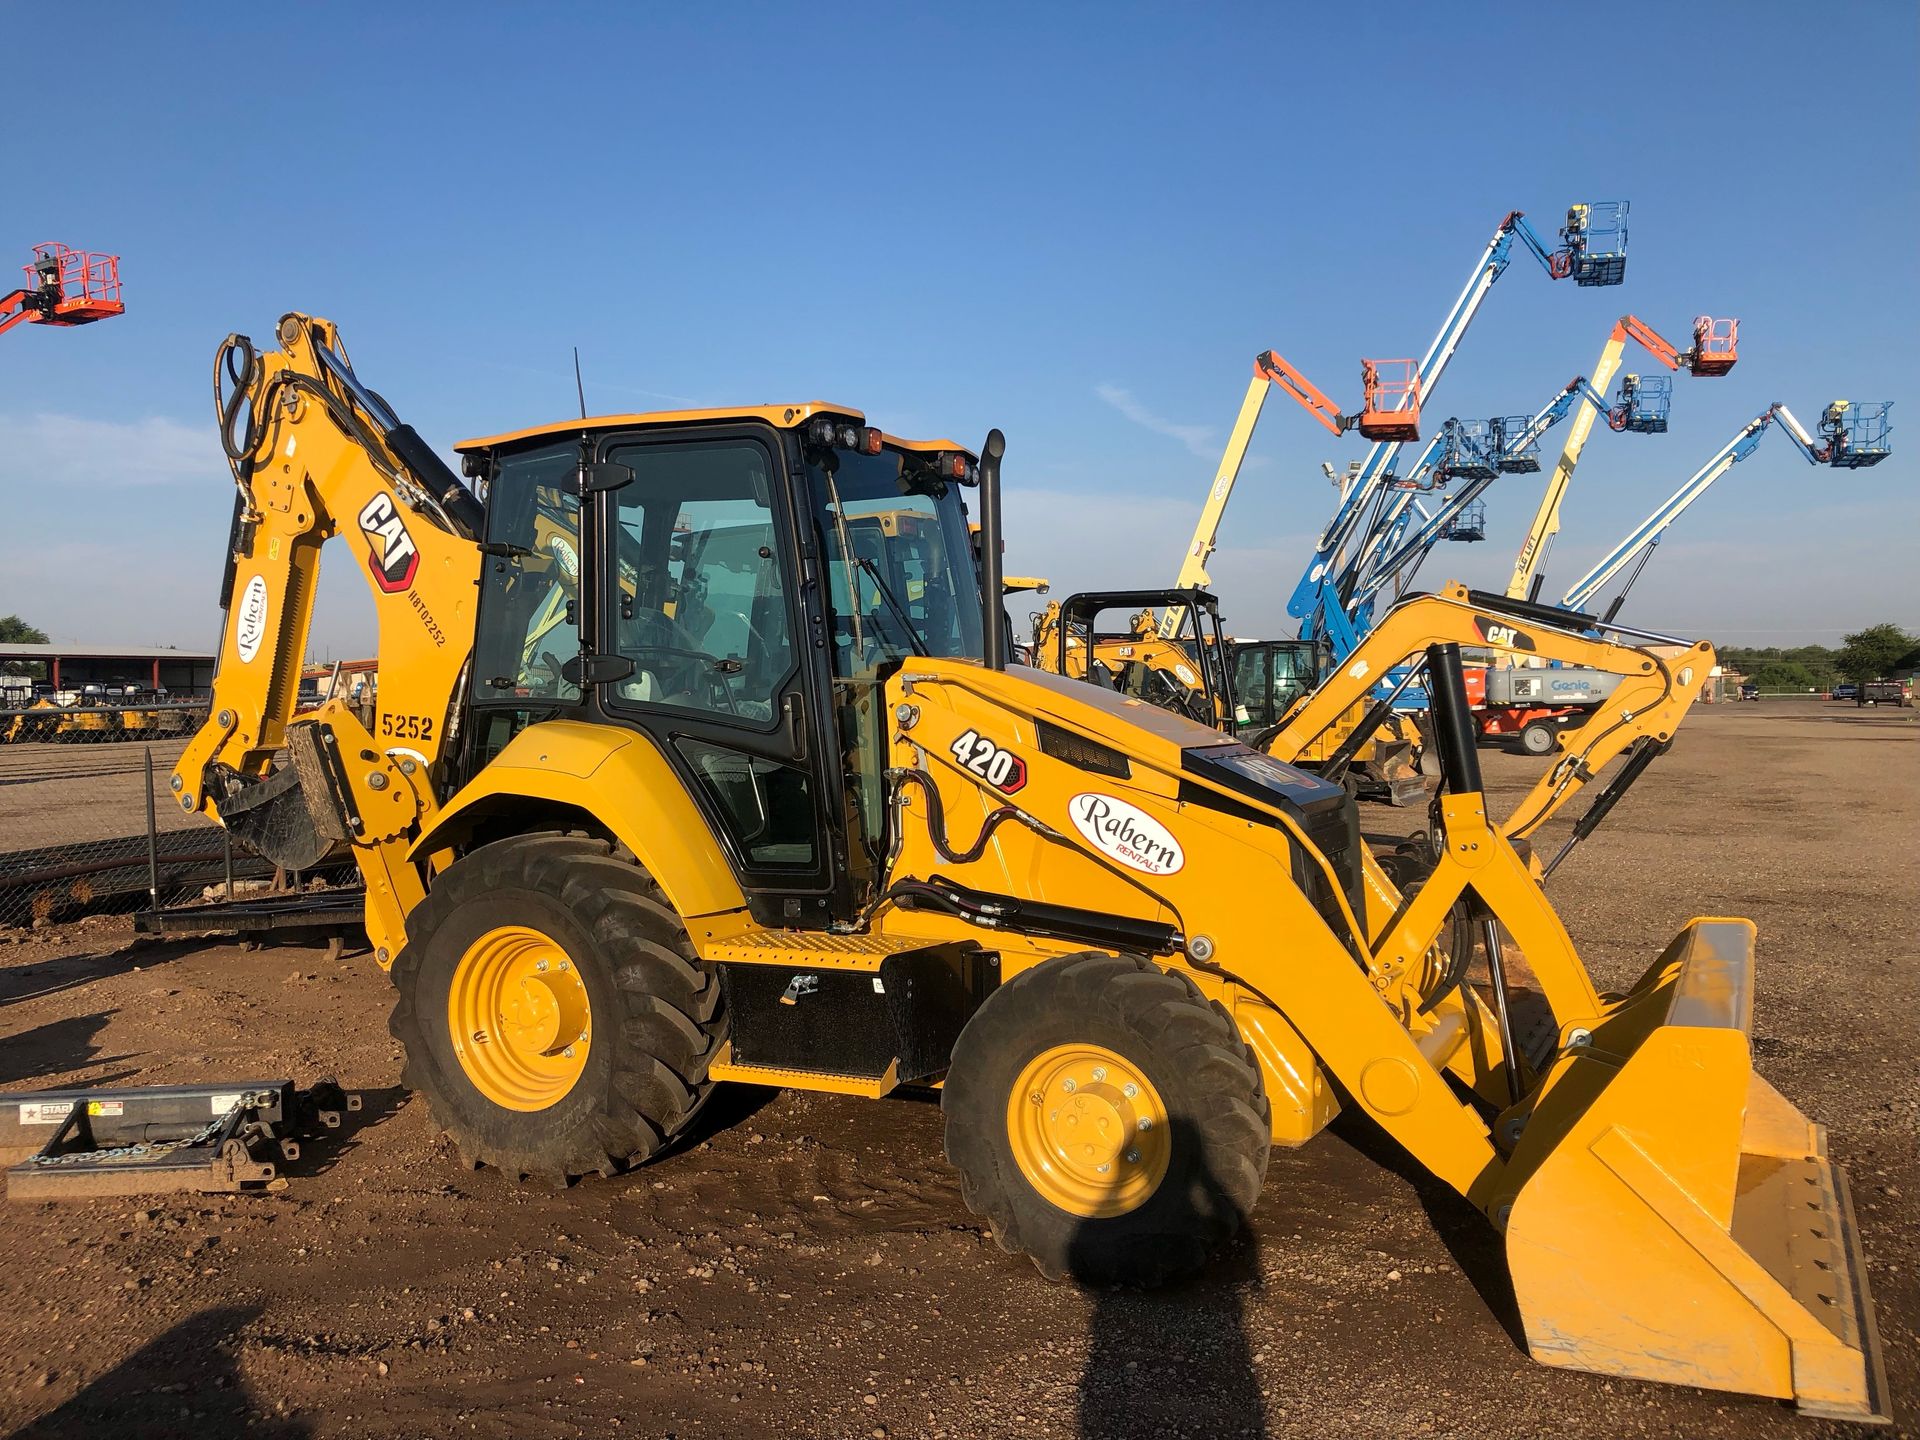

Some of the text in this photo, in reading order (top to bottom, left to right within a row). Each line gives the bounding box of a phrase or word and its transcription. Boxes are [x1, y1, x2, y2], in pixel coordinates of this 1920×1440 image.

[359, 495, 416, 571] CAT
[1518, 535, 1536, 574] JLG LIFT
[240, 582, 262, 656] Rabern
[1119, 648, 1132, 656] CAT
[1487, 626, 1517, 648] CAT
[1550, 679, 1590, 691] Genie
[382, 713, 433, 741] 5252
[951, 730, 1013, 786] 420
[1080, 794, 1176, 868] Rabern
[1116, 843, 1160, 873] RENTALS
[42, 1105, 69, 1114] STAR
